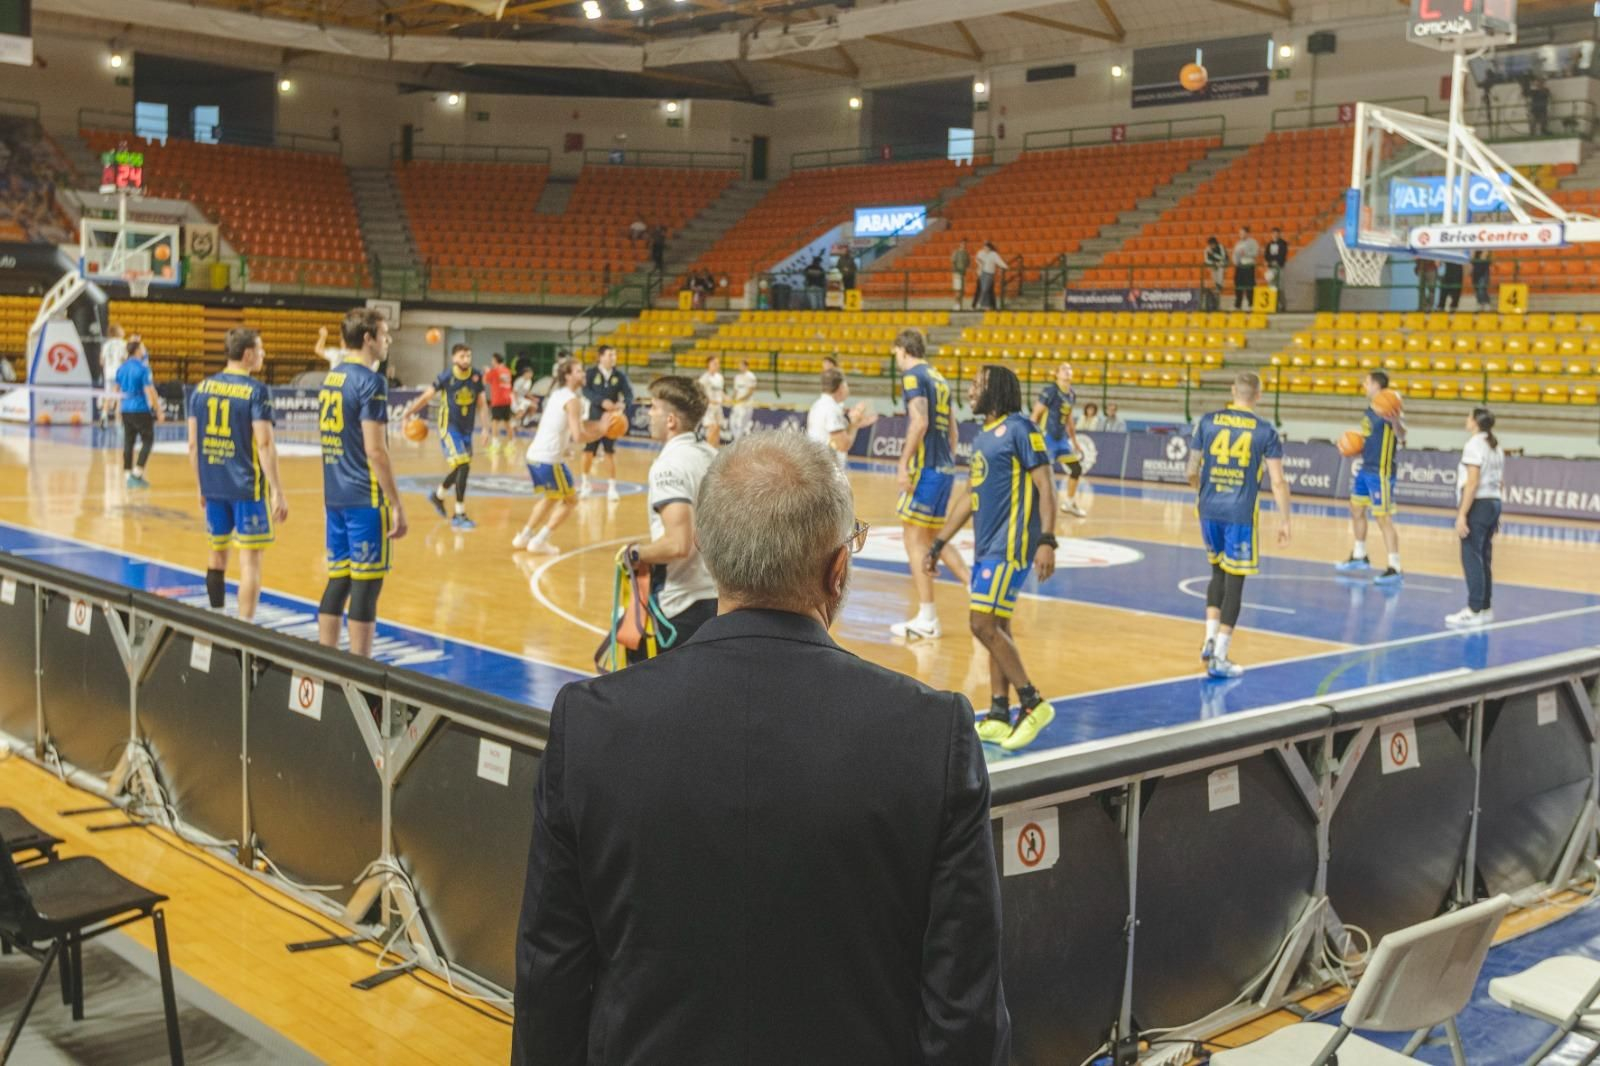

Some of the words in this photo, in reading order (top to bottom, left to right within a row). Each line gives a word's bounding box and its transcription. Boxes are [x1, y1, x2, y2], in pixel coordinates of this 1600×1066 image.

[1114, 128, 1124, 141] 2
[116, 165, 143, 188] 24
[856, 212, 924, 232] ABANCA
[1440, 230, 1529, 243] BricoCentro
[1260, 291, 1270, 308] 3
[1506, 290, 1518, 306] 4
[274, 396, 320, 411] MAPFR
[318, 389, 344, 433] 23
[206, 397, 232, 437] 11
[1209, 428, 1252, 468] 44
[1299, 473, 1331, 488] cost
